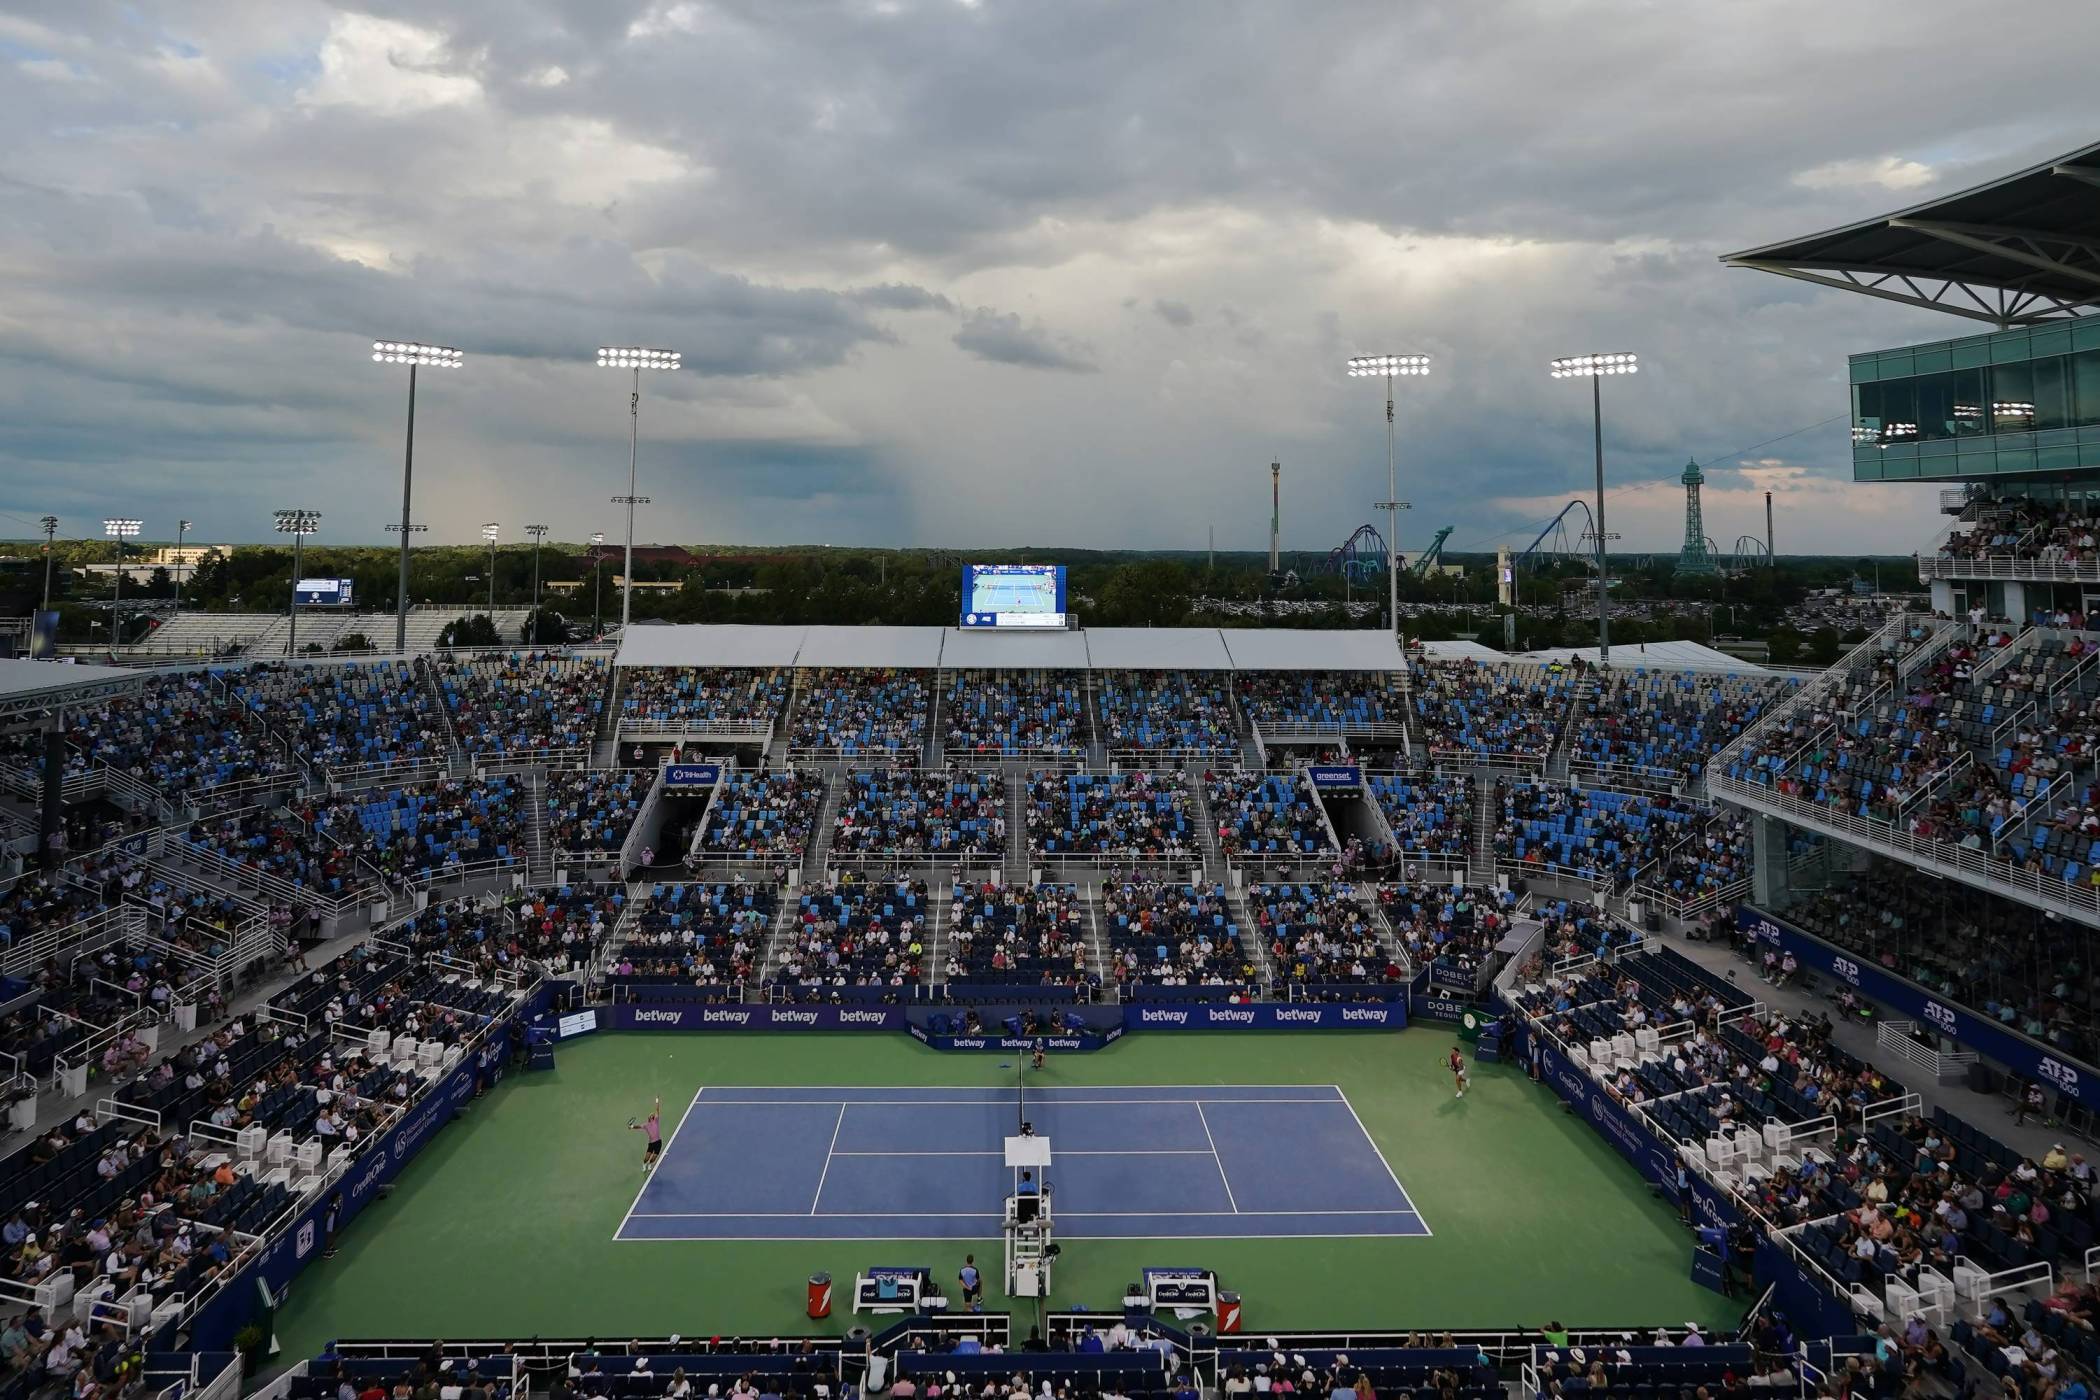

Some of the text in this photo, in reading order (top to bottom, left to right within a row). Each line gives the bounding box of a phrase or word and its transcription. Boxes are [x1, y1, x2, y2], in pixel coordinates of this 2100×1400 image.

[1758, 920, 1779, 937] ATP
[1833, 956, 1858, 976] ATP
[1442, 977, 1464, 986] TEQUILA
[1428, 1001, 1462, 1013] DOBE
[1923, 1001, 1956, 1023] ATP
[635, 1009, 682, 1024] betway
[703, 1009, 750, 1024] betway
[772, 1009, 818, 1024] betway
[840, 1009, 886, 1024] betway
[1142, 1009, 1188, 1024] betway
[1209, 1009, 1255, 1023] betway
[1276, 1008, 1321, 1023] betway
[1342, 1008, 1387, 1023] betway
[1435, 1011, 1461, 1020] TEQUIL
[911, 1026, 928, 1042] betway
[1106, 1026, 1123, 1041] betway
[1940, 1021, 1957, 1035] 1000
[954, 1039, 985, 1048] betway
[1001, 1039, 1033, 1048] betway
[1049, 1039, 1080, 1048] betway
[2037, 1056, 2079, 1084] ATP
[2058, 1081, 2080, 1097] 1000
